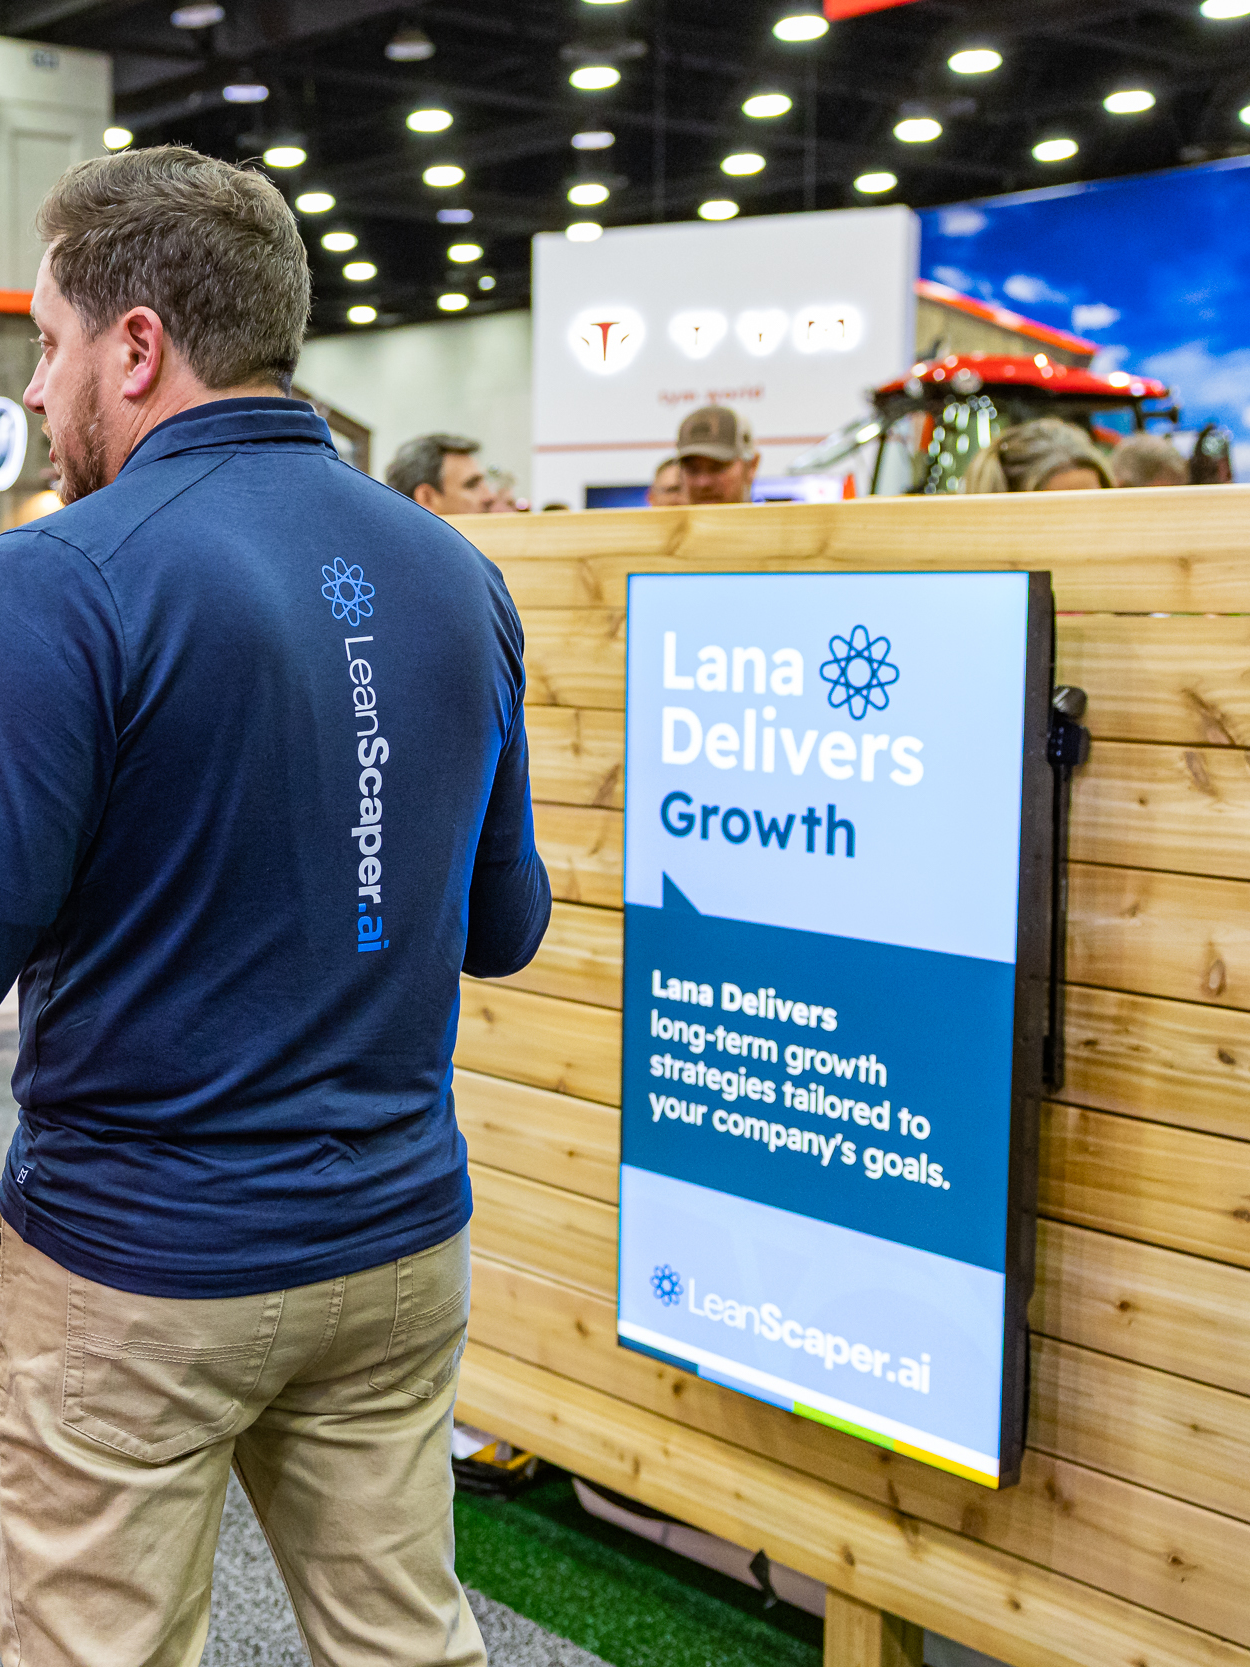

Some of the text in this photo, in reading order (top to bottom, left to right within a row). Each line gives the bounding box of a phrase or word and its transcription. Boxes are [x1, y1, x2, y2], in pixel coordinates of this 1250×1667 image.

[662, 631, 805, 697] Lana
[661, 706, 925, 787] Delivers
[344, 635, 390, 953] LeanScaper.ai
[660, 790, 857, 859] Growth
[651, 969, 838, 1032] Lana Delivers
[650, 1008, 887, 1088] long-term growth
[649, 1053, 931, 1140] strategies tailored to
[649, 1092, 709, 1126] your
[862, 1143, 951, 1191] goals.
[687, 1278, 932, 1394] LeanScaper.ai
